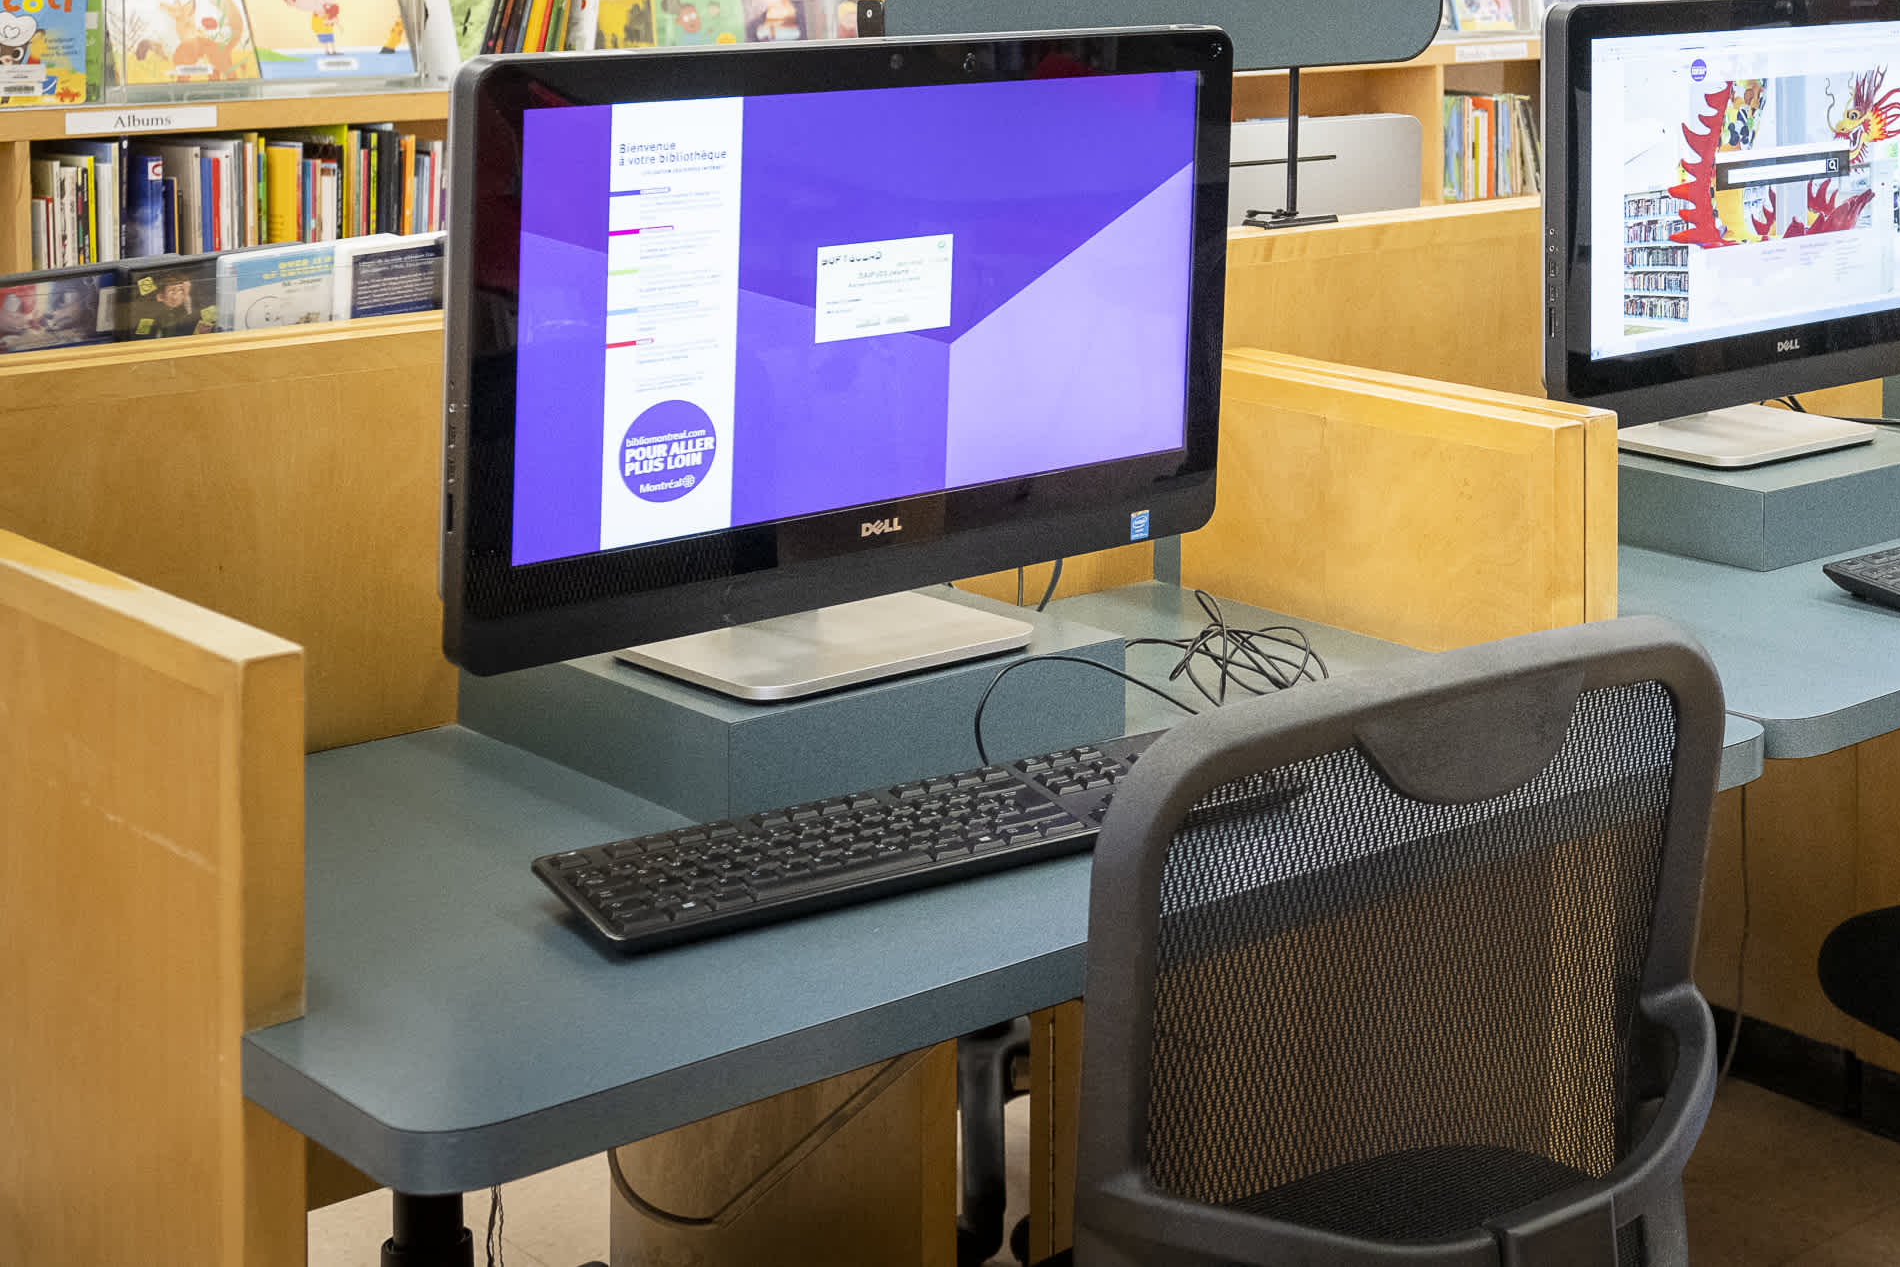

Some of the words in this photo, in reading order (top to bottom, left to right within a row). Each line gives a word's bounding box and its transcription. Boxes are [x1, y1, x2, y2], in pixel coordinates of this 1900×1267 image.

[113, 114, 173, 129] Albums
[619, 140, 676, 154] Bienvenue
[619, 155, 625, 166] à
[628, 155, 656, 166] votre
[658, 148, 728, 165] bibliothèque
[1776, 338, 1801, 352] DELL
[624, 444, 667, 463] POUR
[668, 436, 716, 456] ALLER
[624, 458, 665, 477] PLUS
[666, 451, 703, 470] LOIN
[639, 476, 684, 494] Montréal
[861, 517, 902, 538] DELL
